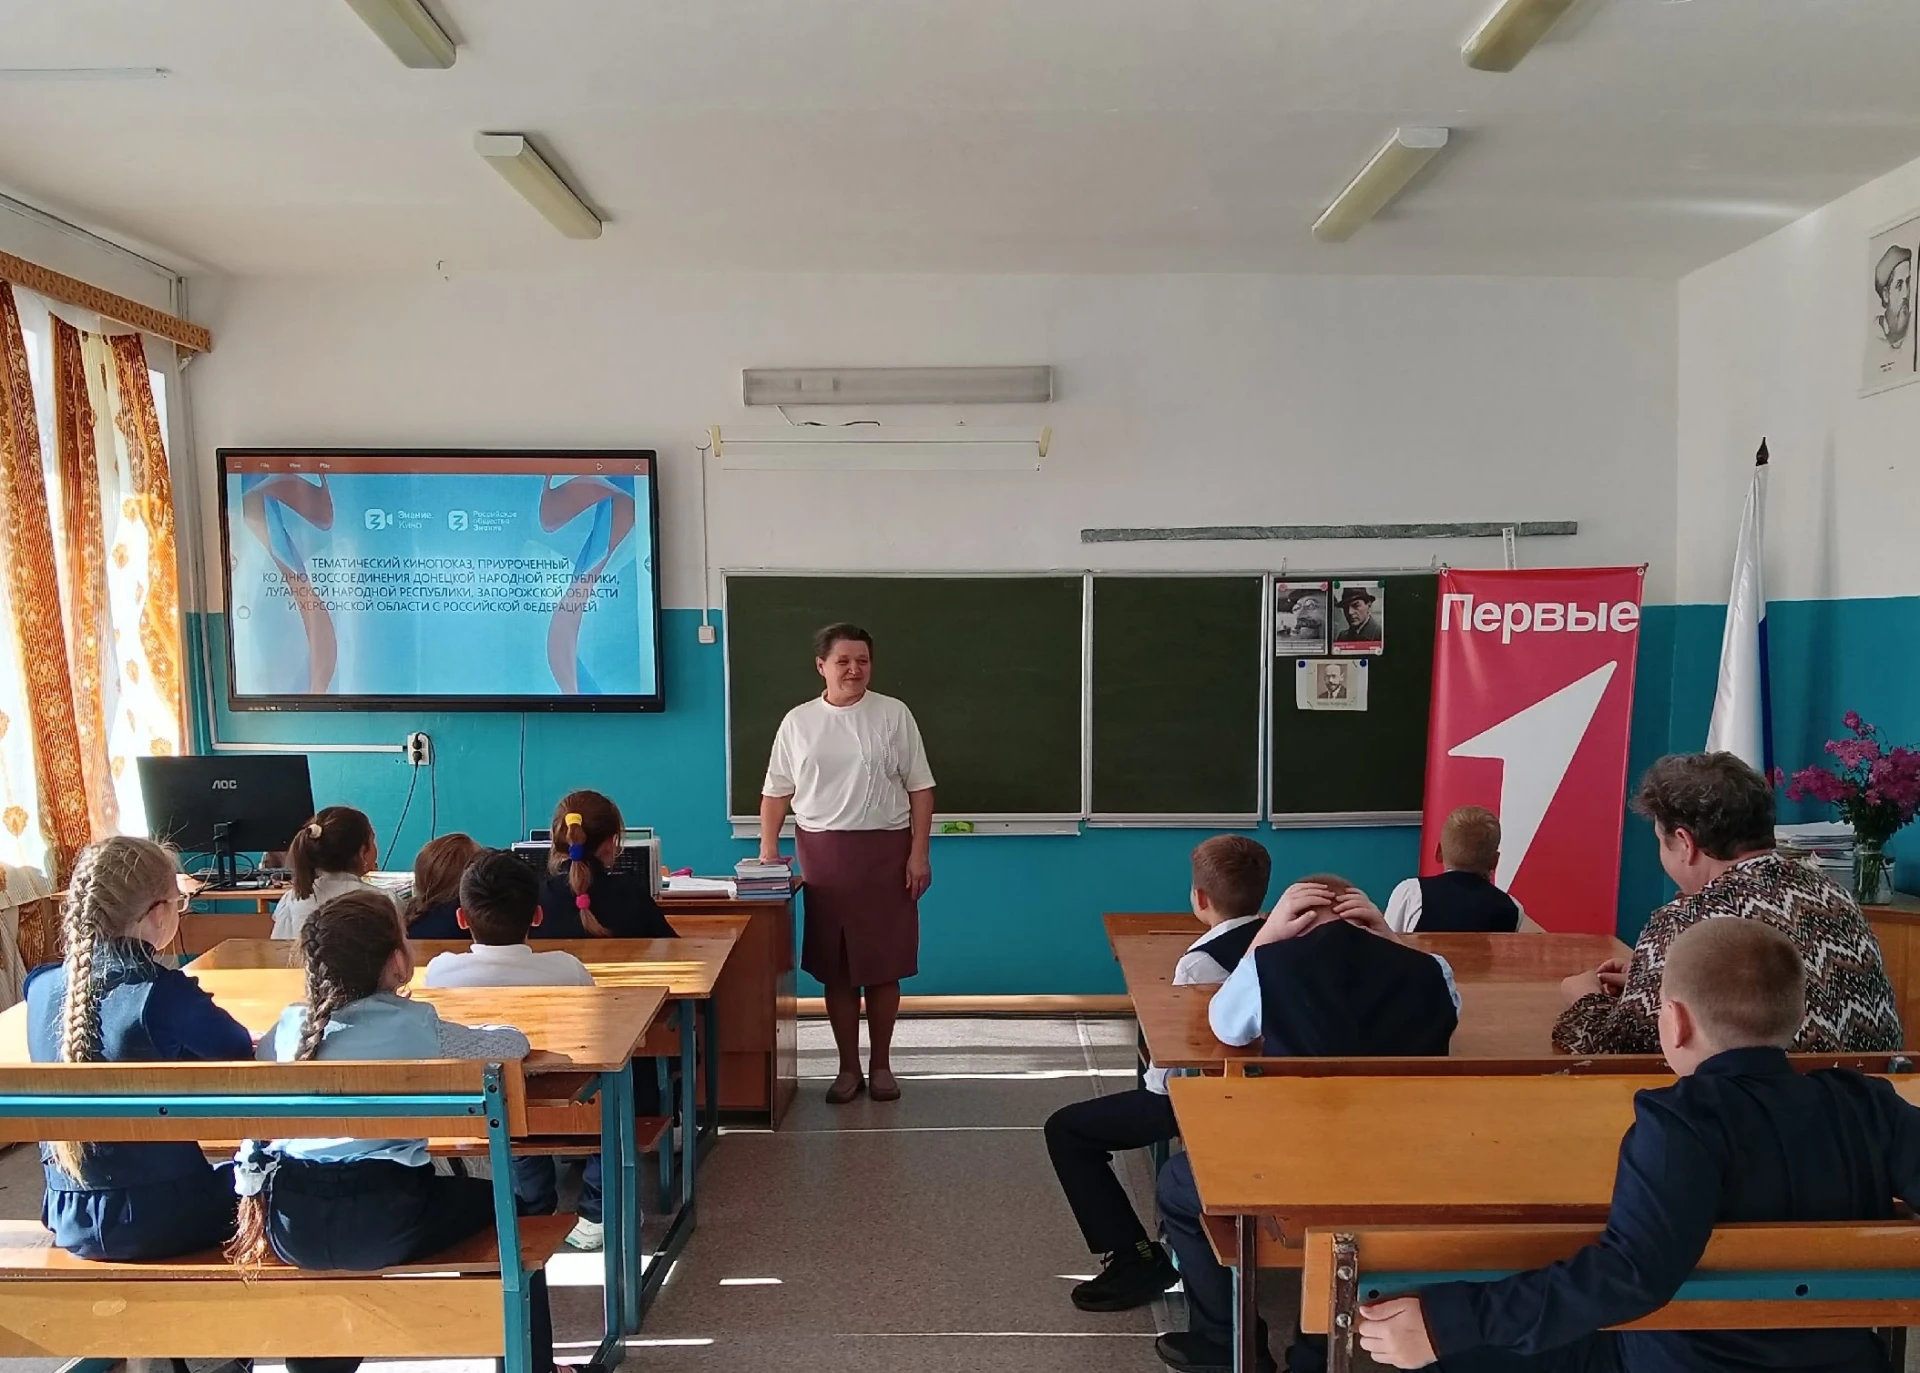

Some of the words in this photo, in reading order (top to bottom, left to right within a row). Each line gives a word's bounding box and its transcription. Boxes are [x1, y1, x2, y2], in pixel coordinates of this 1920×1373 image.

[398, 521, 422, 529] Кино
[312, 557, 400, 569] ТЕМАТИЧЕСКИЙ
[403, 558, 475, 570] КИНОПОКАЗ,
[478, 557, 569, 569] ПРИУРОЧЕННЫЙ
[262, 573, 278, 583] КО
[280, 573, 308, 584] ДНЮ
[311, 573, 410, 584] ВОССОЕДИНЕНИЯ
[413, 572, 476, 585] ДОНЕЦКОЙ
[479, 572, 543, 585] НАРОДНОЙ
[546, 573, 620, 585] РЕСПУБЛИКИ,
[265, 586, 329, 597] ЛУГАНСКОЙ
[332, 586, 397, 598] НАРОДНОЙ
[400, 587, 474, 598] РЕСПУБЛИКИ,
[477, 586, 563, 598] ЗАПОРОЖСКОЙ
[566, 588, 619, 598] ОБЛАСТИ
[288, 601, 297, 611] И
[300, 600, 374, 611] ХЕРСОНСКОЙ
[377, 601, 430, 611] ОБЛАСТИ
[433, 602, 441, 611] С
[443, 600, 520, 612] РОССИЙСКОЙ
[523, 600, 597, 613] ФЕДЕРАЦИЕЙ
[1441, 593, 1640, 644] Первые
[212, 780, 237, 789] AOC
